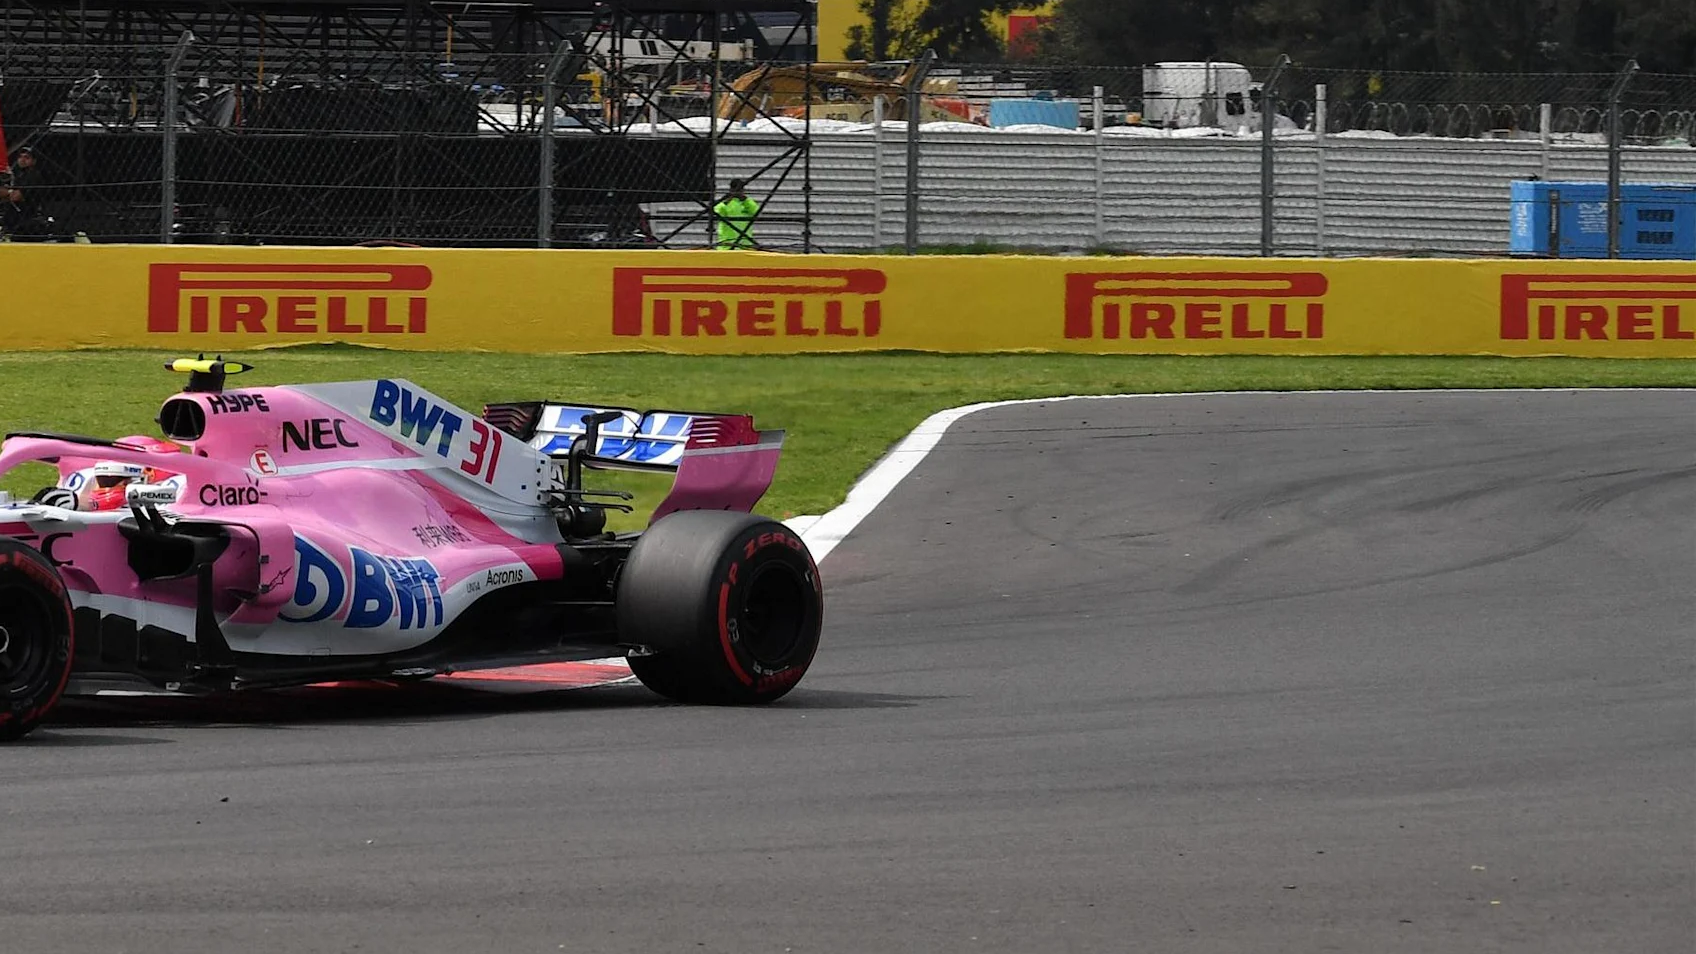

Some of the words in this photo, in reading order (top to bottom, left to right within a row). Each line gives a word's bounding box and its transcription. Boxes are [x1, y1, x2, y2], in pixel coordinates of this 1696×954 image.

[147, 262, 433, 334] PIRELLI
[611, 266, 888, 337] PIRELLI
[1064, 271, 1329, 339] PIRELLI
[206, 393, 271, 415] HYPE
[282, 418, 360, 453] NEC
[369, 379, 463, 458] BWT
[460, 418, 504, 486] 31
[255, 453, 275, 474] E
[140, 491, 174, 500] PEMEX
[343, 545, 445, 630] BWT
[485, 568, 524, 587] Acronis
